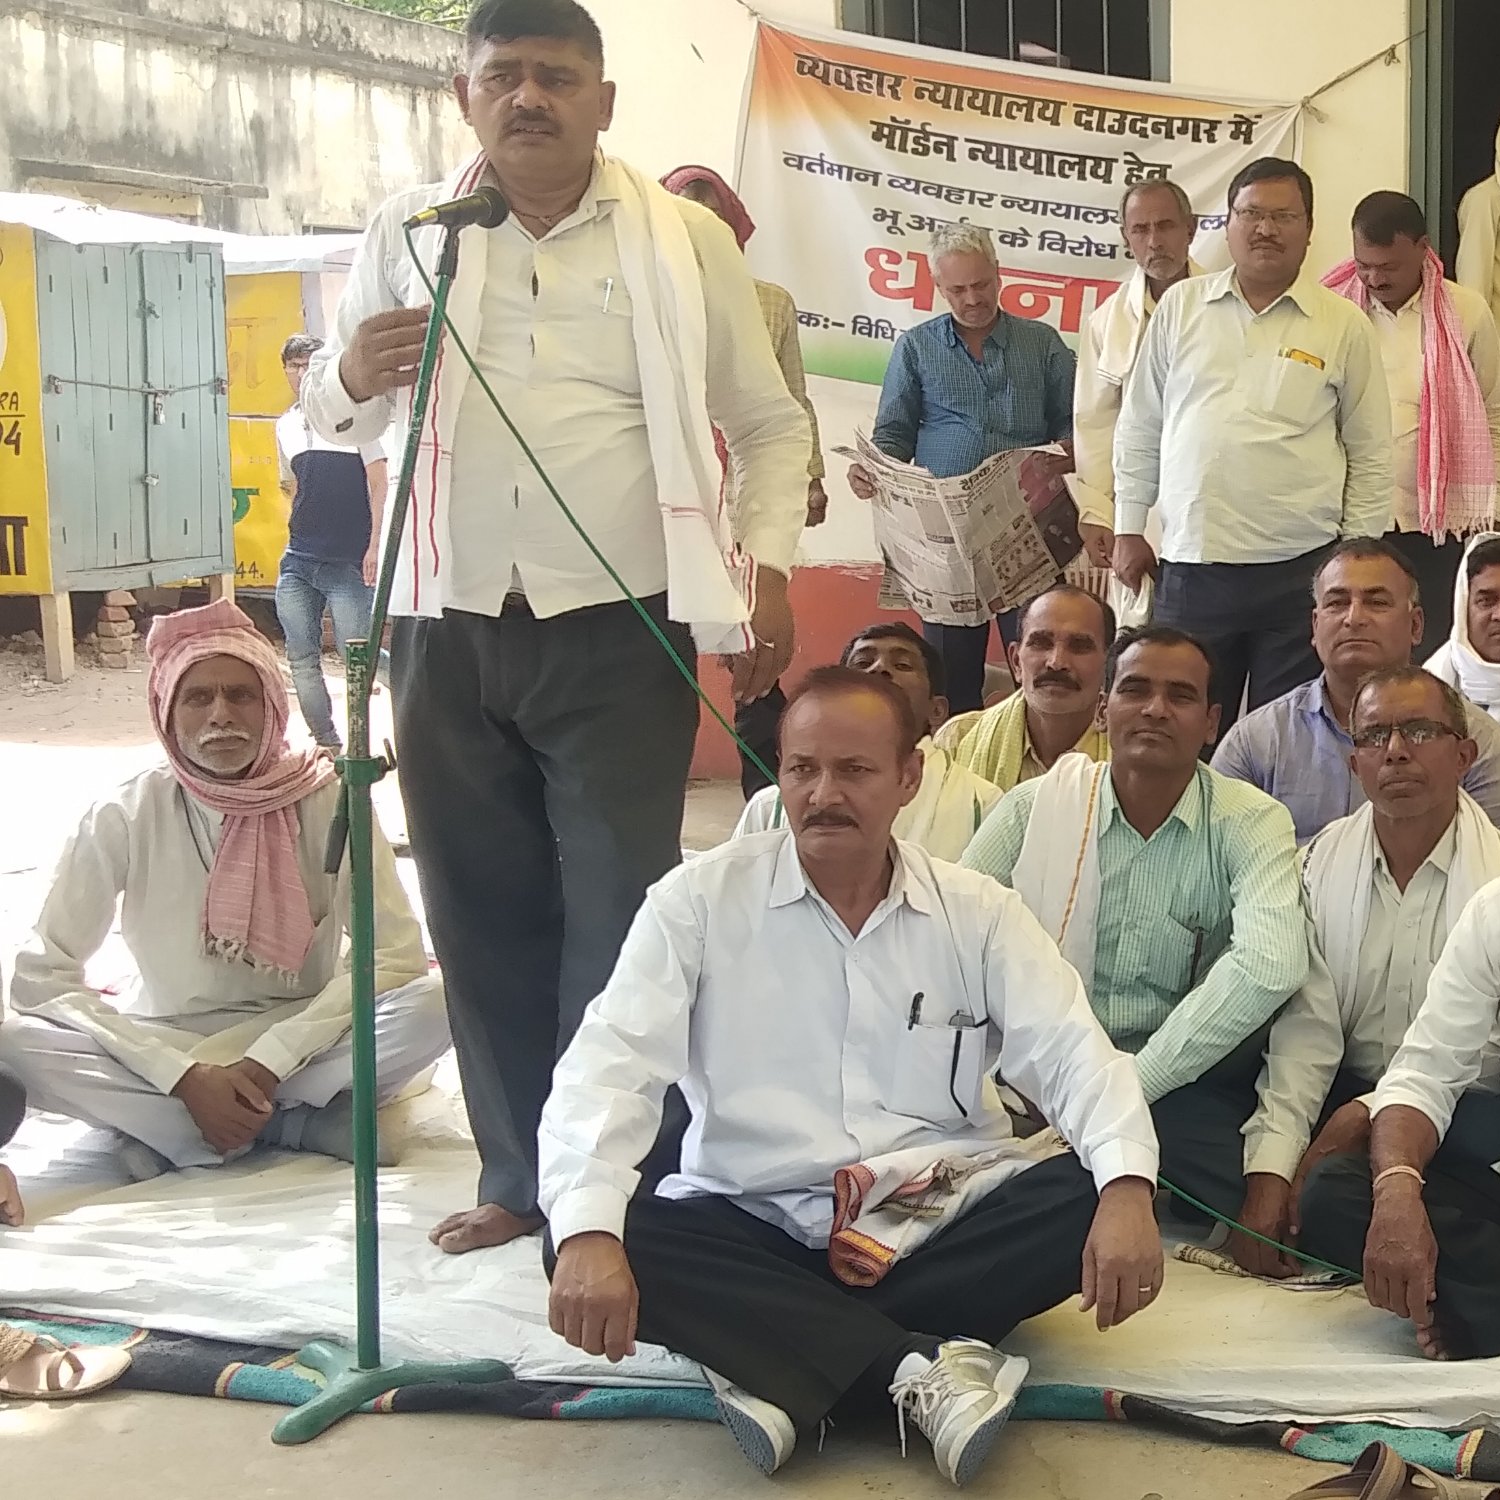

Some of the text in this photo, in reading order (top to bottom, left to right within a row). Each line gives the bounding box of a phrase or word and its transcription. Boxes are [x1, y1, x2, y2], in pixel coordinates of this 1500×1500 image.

[793, 51, 1262, 145] व्यवहार न्यायालय दाउदनगर में
[782, 151, 882, 187] वर्तमान
[887, 173, 998, 208] व्यवहार
[870, 115, 958, 162] मॉर्डन
[965, 137, 1118, 184] न्यायालय
[872, 206, 907, 236] भू
[998, 224, 1029, 249] के
[1037, 231, 1117, 260] विरोध
[864, 247, 1122, 334] धना
[851, 315, 897, 342] विधि
